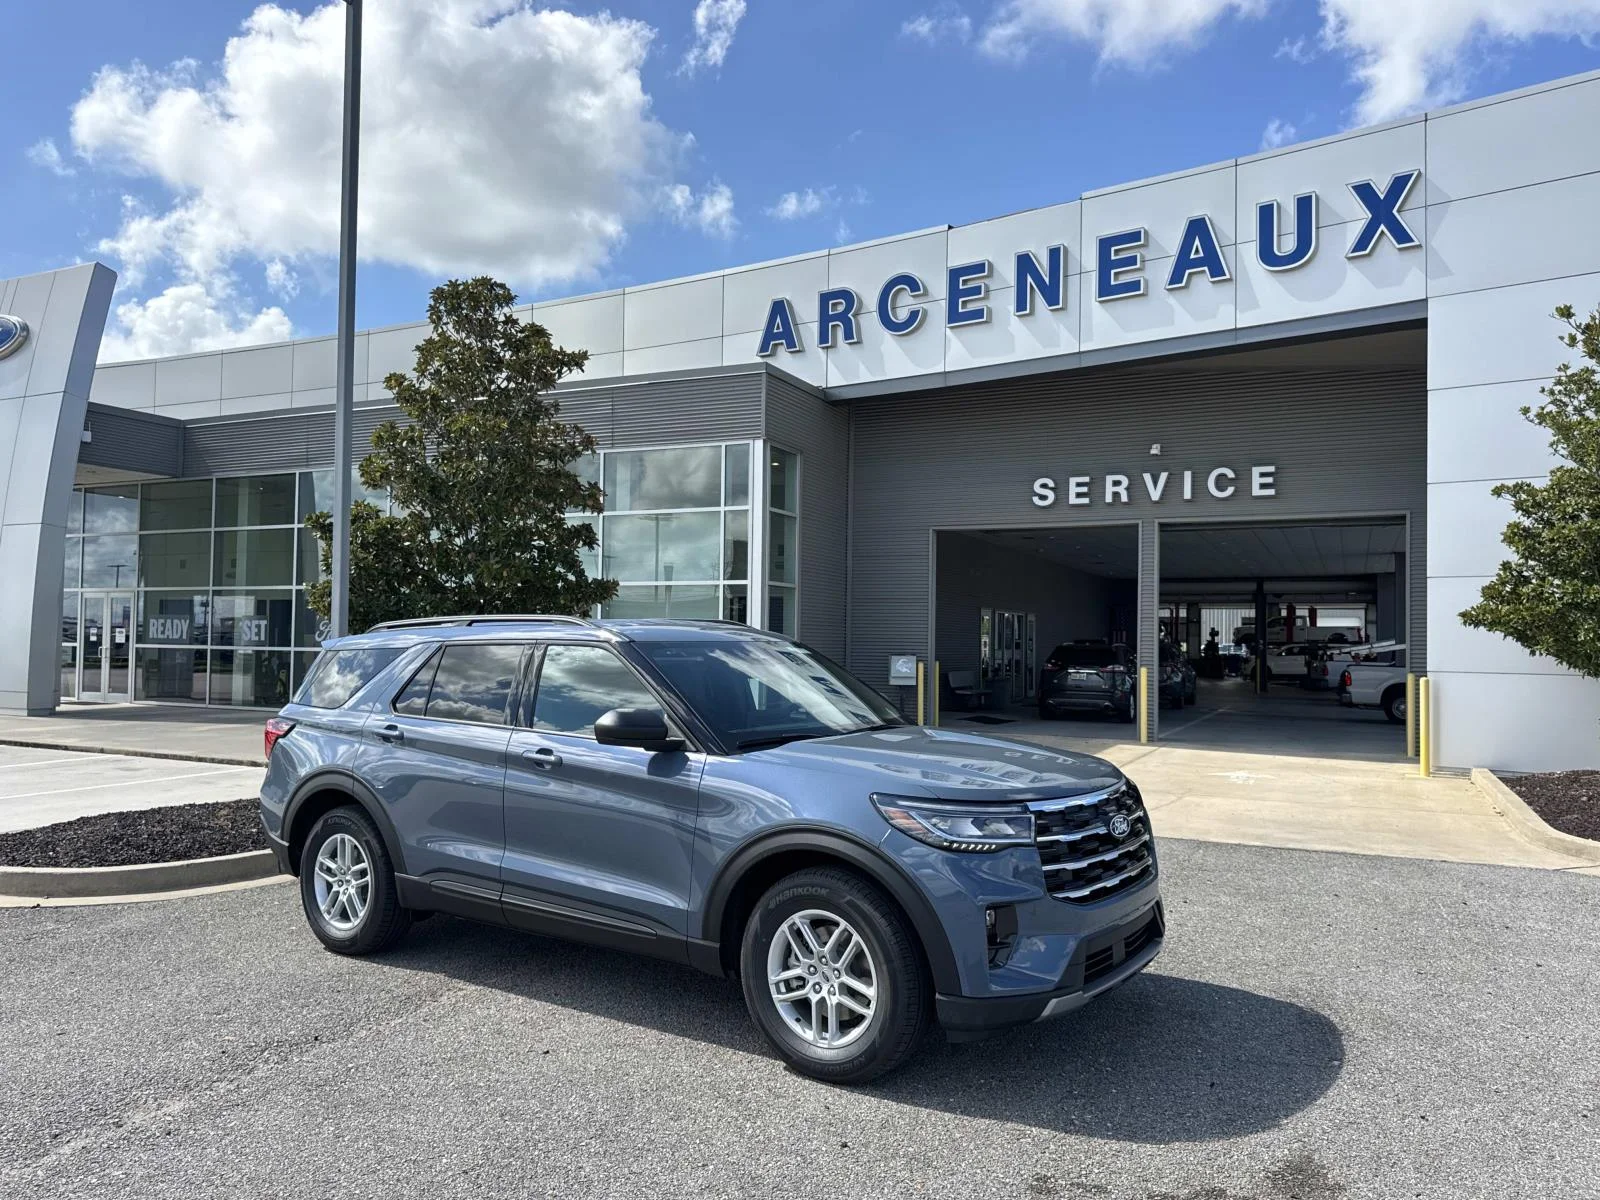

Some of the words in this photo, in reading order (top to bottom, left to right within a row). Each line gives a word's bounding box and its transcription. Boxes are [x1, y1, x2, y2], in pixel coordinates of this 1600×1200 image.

[757, 168, 1422, 357] ARCENEAUX
[1032, 465, 1276, 506] SERVICE
[148, 618, 190, 640] READY
[242, 619, 268, 641] SET
